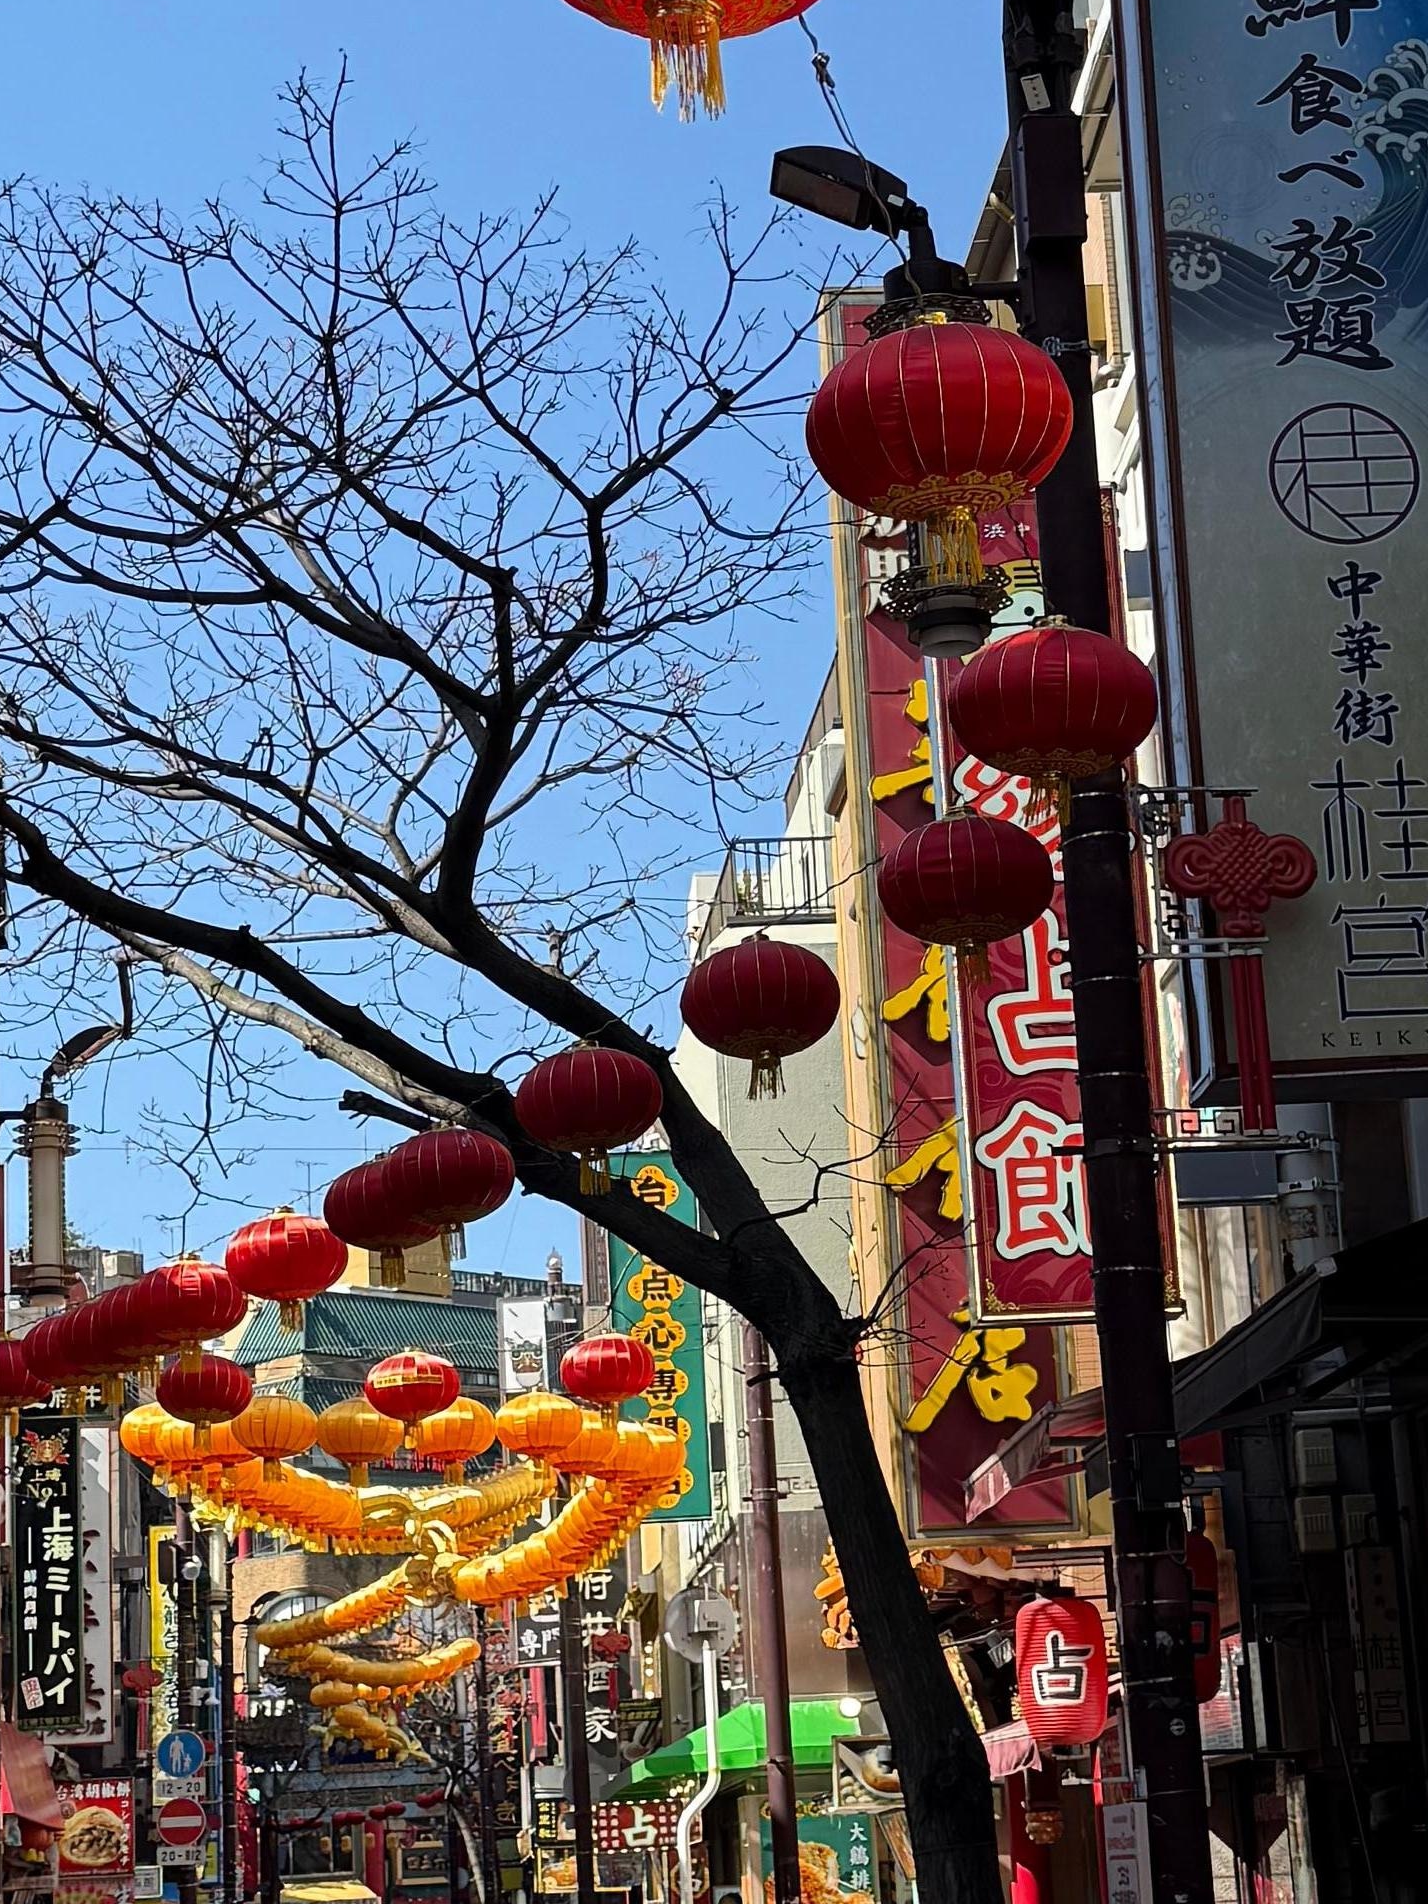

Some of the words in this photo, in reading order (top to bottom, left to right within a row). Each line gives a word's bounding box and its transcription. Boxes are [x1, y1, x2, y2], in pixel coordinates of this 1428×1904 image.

[1326, 560, 1400, 747] 中華街
[638, 1175, 684, 1496] 台点心専
[41, 1506, 75, 1706] 上海ミートパイ
[1031, 1629, 1095, 1706] 占
[160, 1781, 202, 1794] 12-20
[621, 1805, 658, 1848] 占
[848, 1822, 871, 1892] 大鶏排
